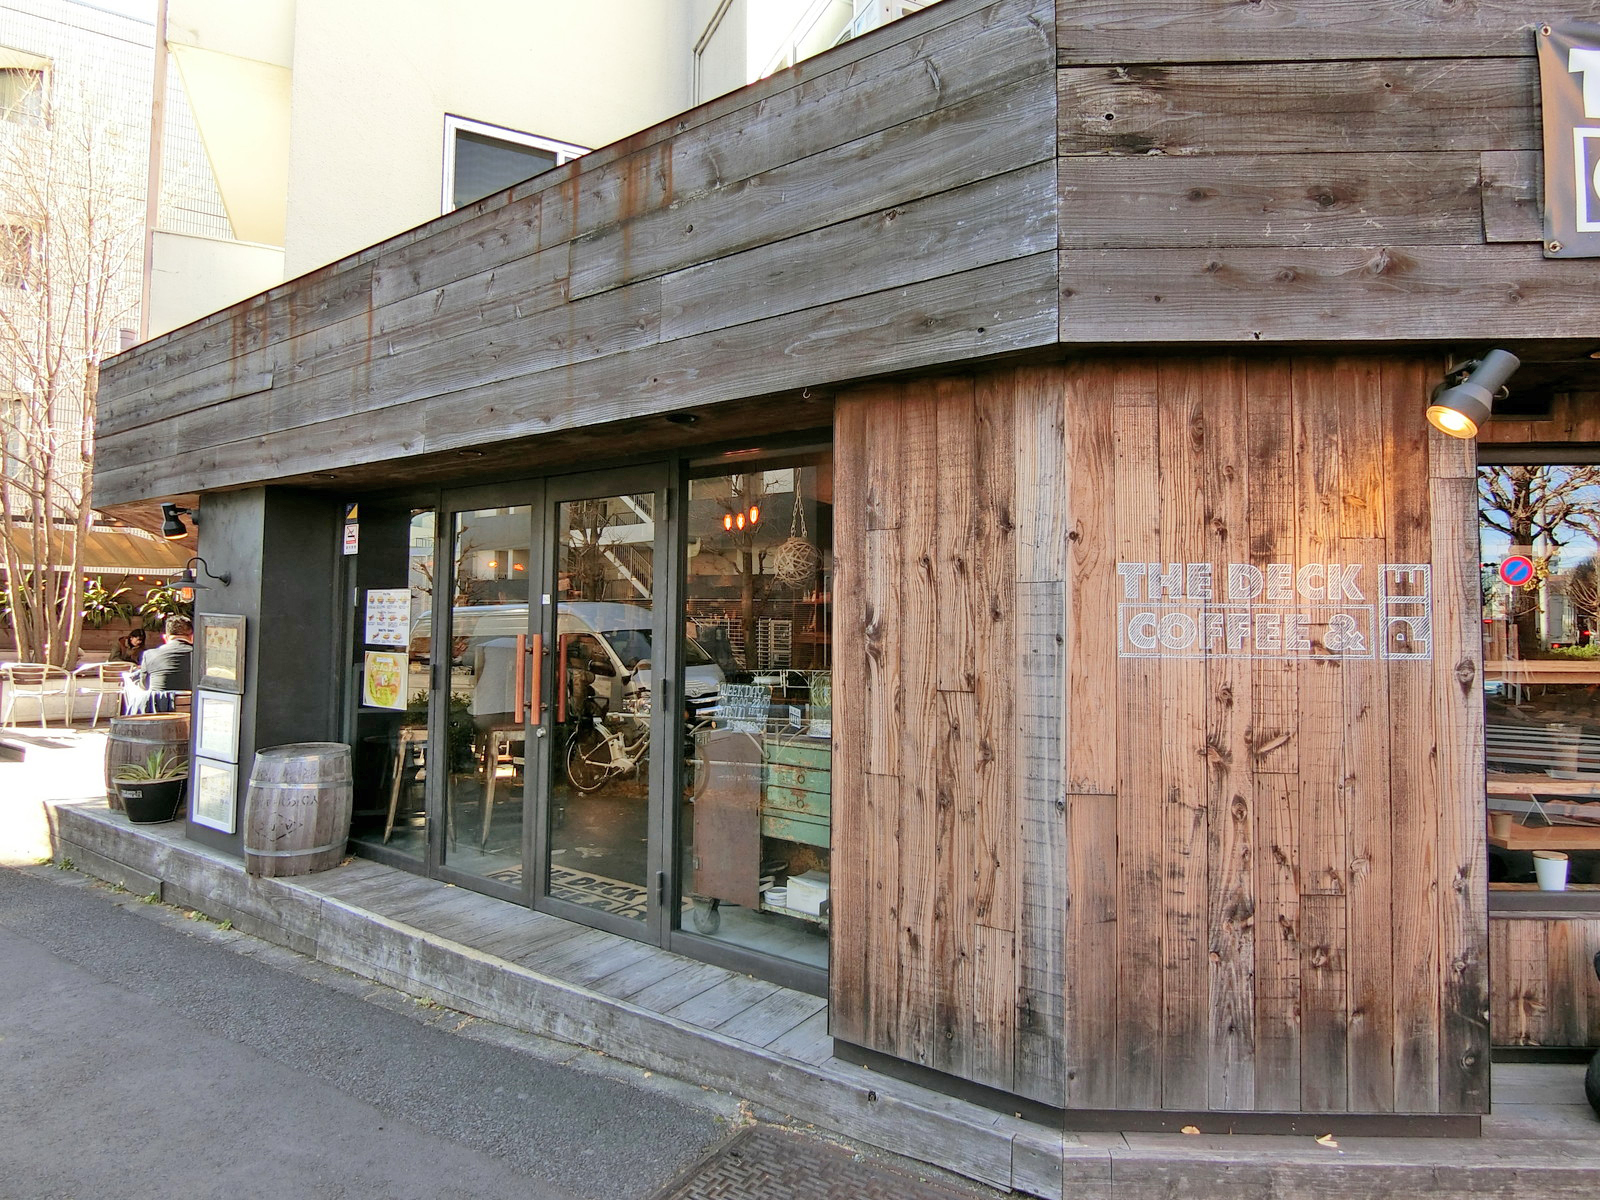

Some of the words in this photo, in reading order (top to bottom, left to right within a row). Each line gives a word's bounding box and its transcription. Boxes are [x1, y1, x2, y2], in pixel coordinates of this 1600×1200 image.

[1117, 562, 1213, 599] THE
[1228, 563, 1366, 601] DECK
[1127, 612, 1312, 651] COFFEE
[1323, 613, 1366, 652] &
